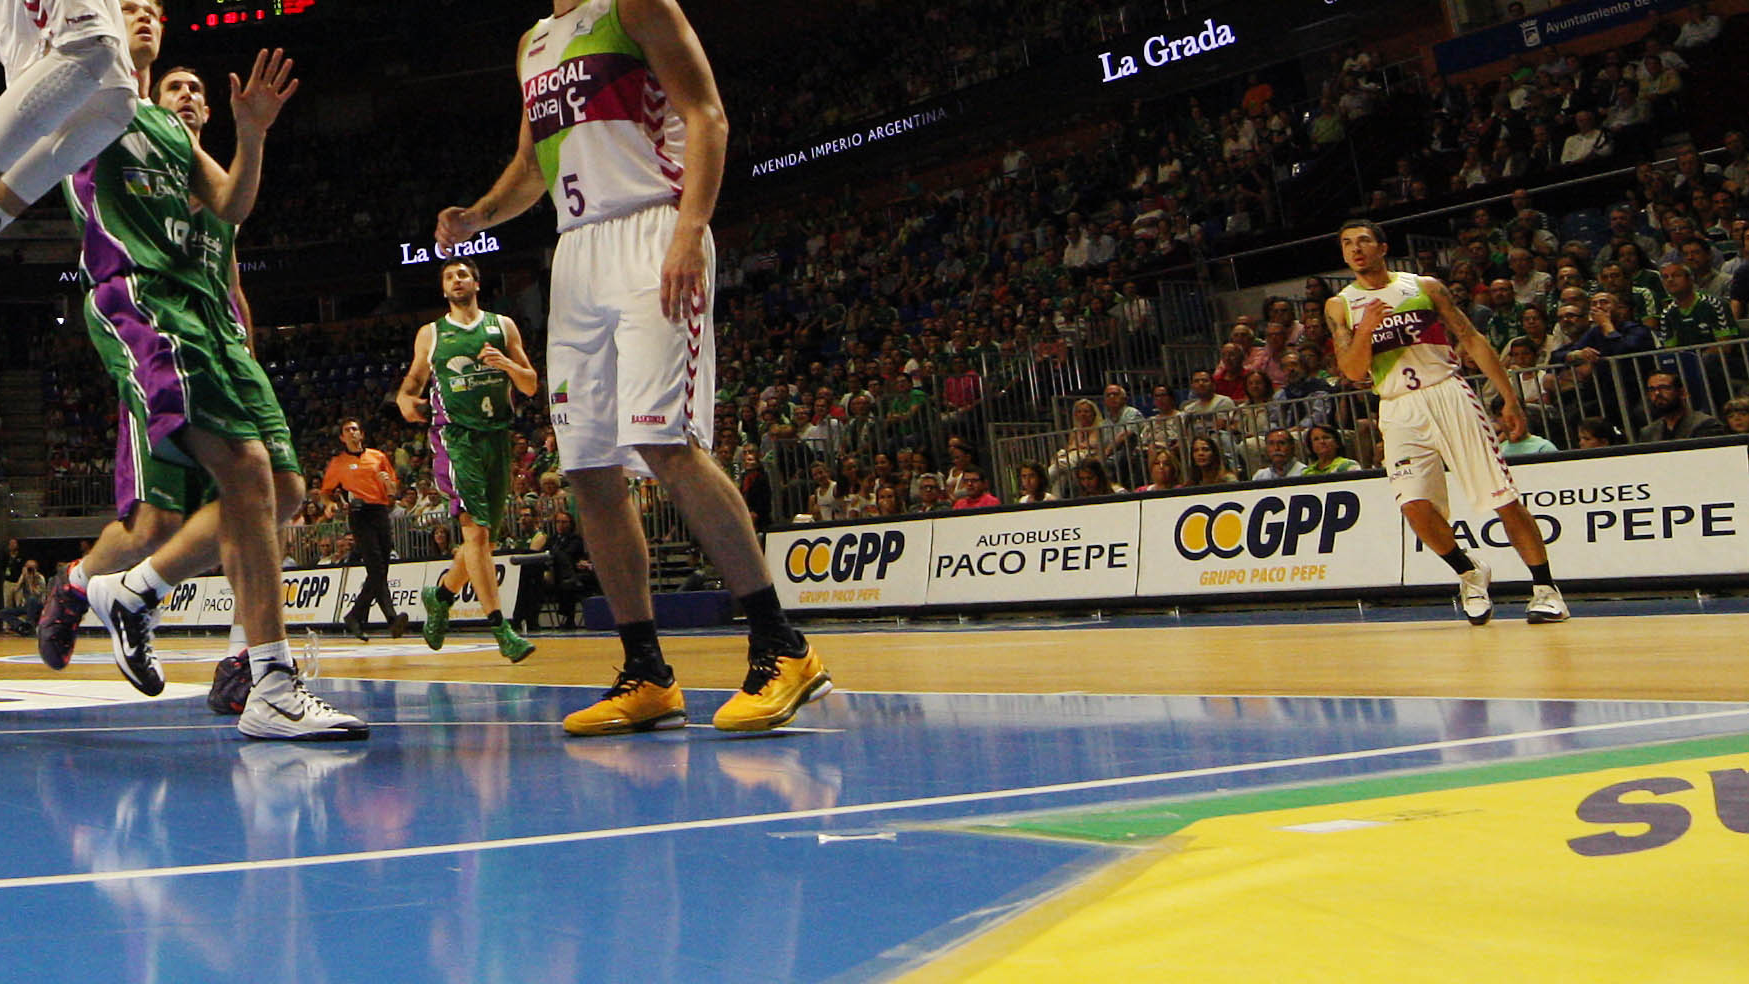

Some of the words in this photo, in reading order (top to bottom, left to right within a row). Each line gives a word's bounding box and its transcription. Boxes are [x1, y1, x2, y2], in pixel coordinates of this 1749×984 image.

[1545, 0, 1632, 35] Ayuntamiento
[1098, 51, 1138, 83] La
[1143, 18, 1236, 67] Grada
[522, 60, 591, 100] LABORAL
[527, 96, 559, 123] utxa
[752, 151, 808, 177] AVENIDA
[811, 133, 862, 159] IMPERIO
[868, 106, 948, 142] ARGENTINA
[562, 173, 586, 217] 5
[401, 243, 429, 265] La
[1402, 368, 1421, 391] 3
[481, 396, 494, 417] 4
[1521, 483, 1651, 509] TOBUSES
[976, 527, 1081, 547] AUTOBUSES
[1415, 513, 1561, 553] ACO
[1586, 502, 1736, 543] PEPE
[936, 550, 1026, 578] PACO
[1040, 543, 1129, 572] PEPE
[1200, 569, 1246, 586] GRUPO
[1250, 567, 1285, 584] PACO
[1291, 564, 1327, 582] PEPE
[203, 598, 233, 612] PACO
[392, 590, 419, 607] EPE
